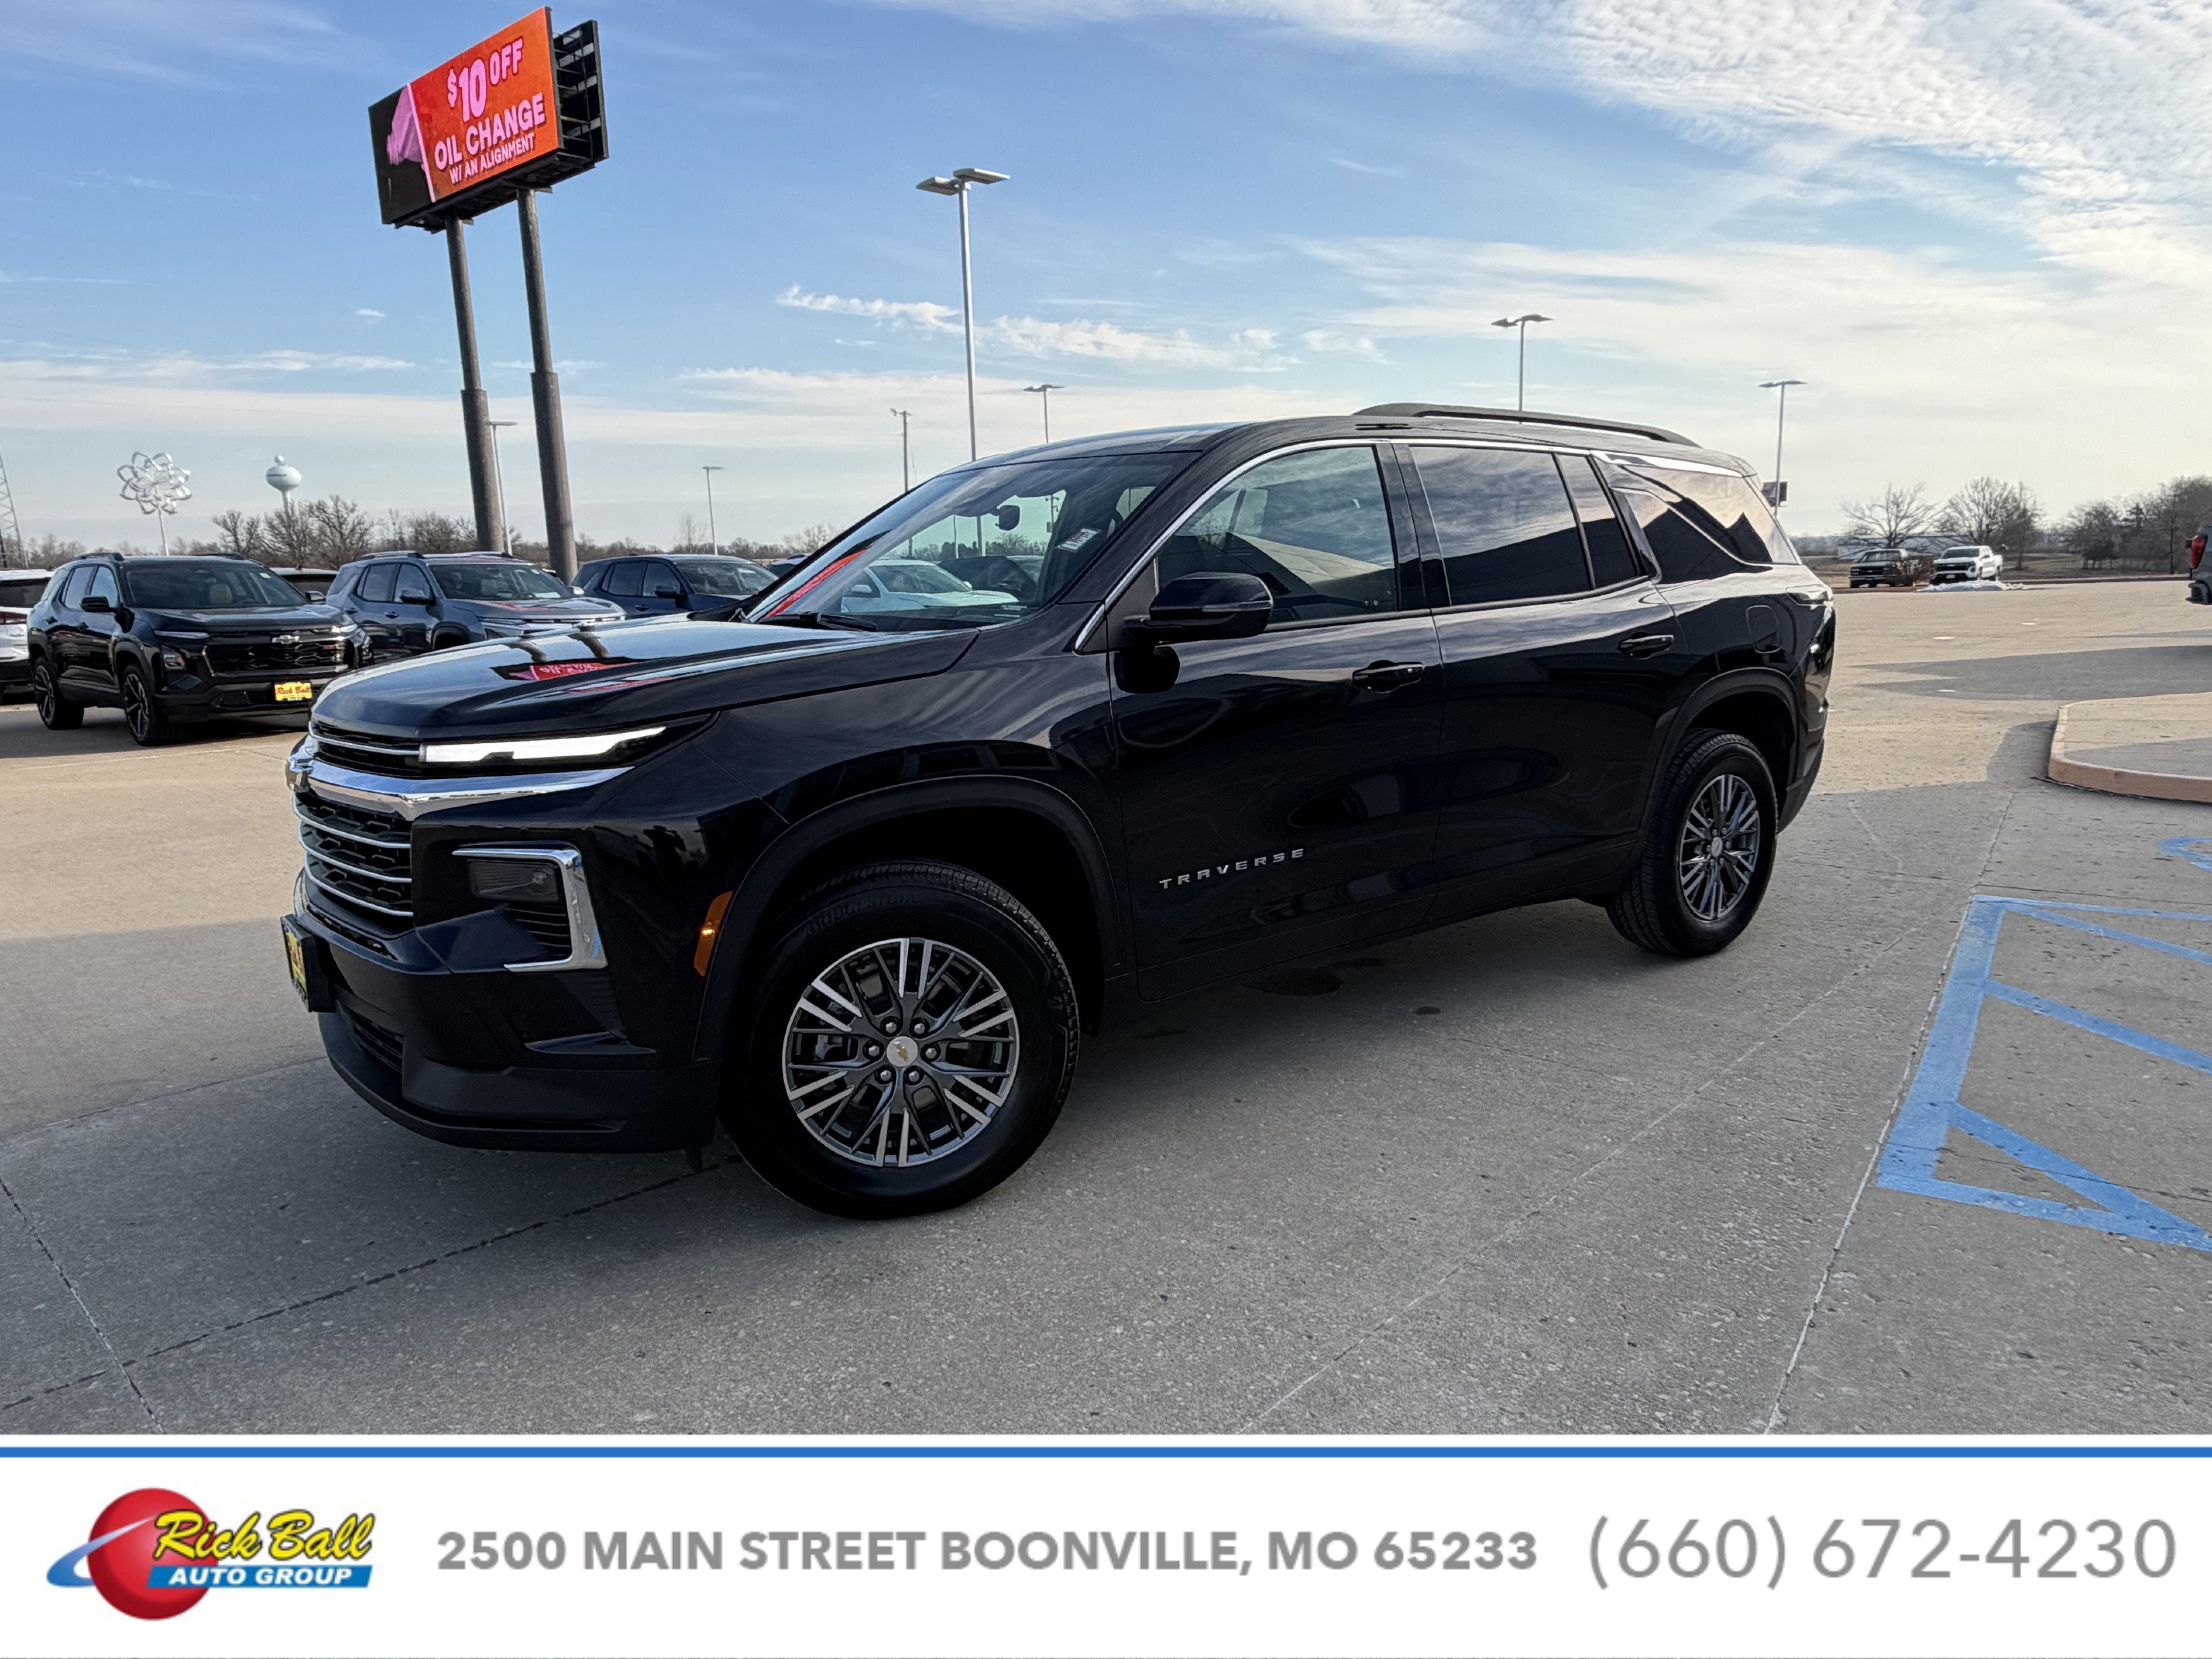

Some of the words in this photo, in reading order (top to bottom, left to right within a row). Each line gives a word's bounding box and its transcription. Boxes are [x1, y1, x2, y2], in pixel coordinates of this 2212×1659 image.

[447, 59, 487, 122] $10
[489, 39, 523, 85] OFF
[434, 136, 463, 170] OIL
[466, 93, 545, 155] CHANGE
[449, 164, 462, 184] W/
[464, 159, 479, 178] AN
[480, 132, 535, 172] ALIGNMENT
[1159, 848, 1304, 889] TRAVERSE
